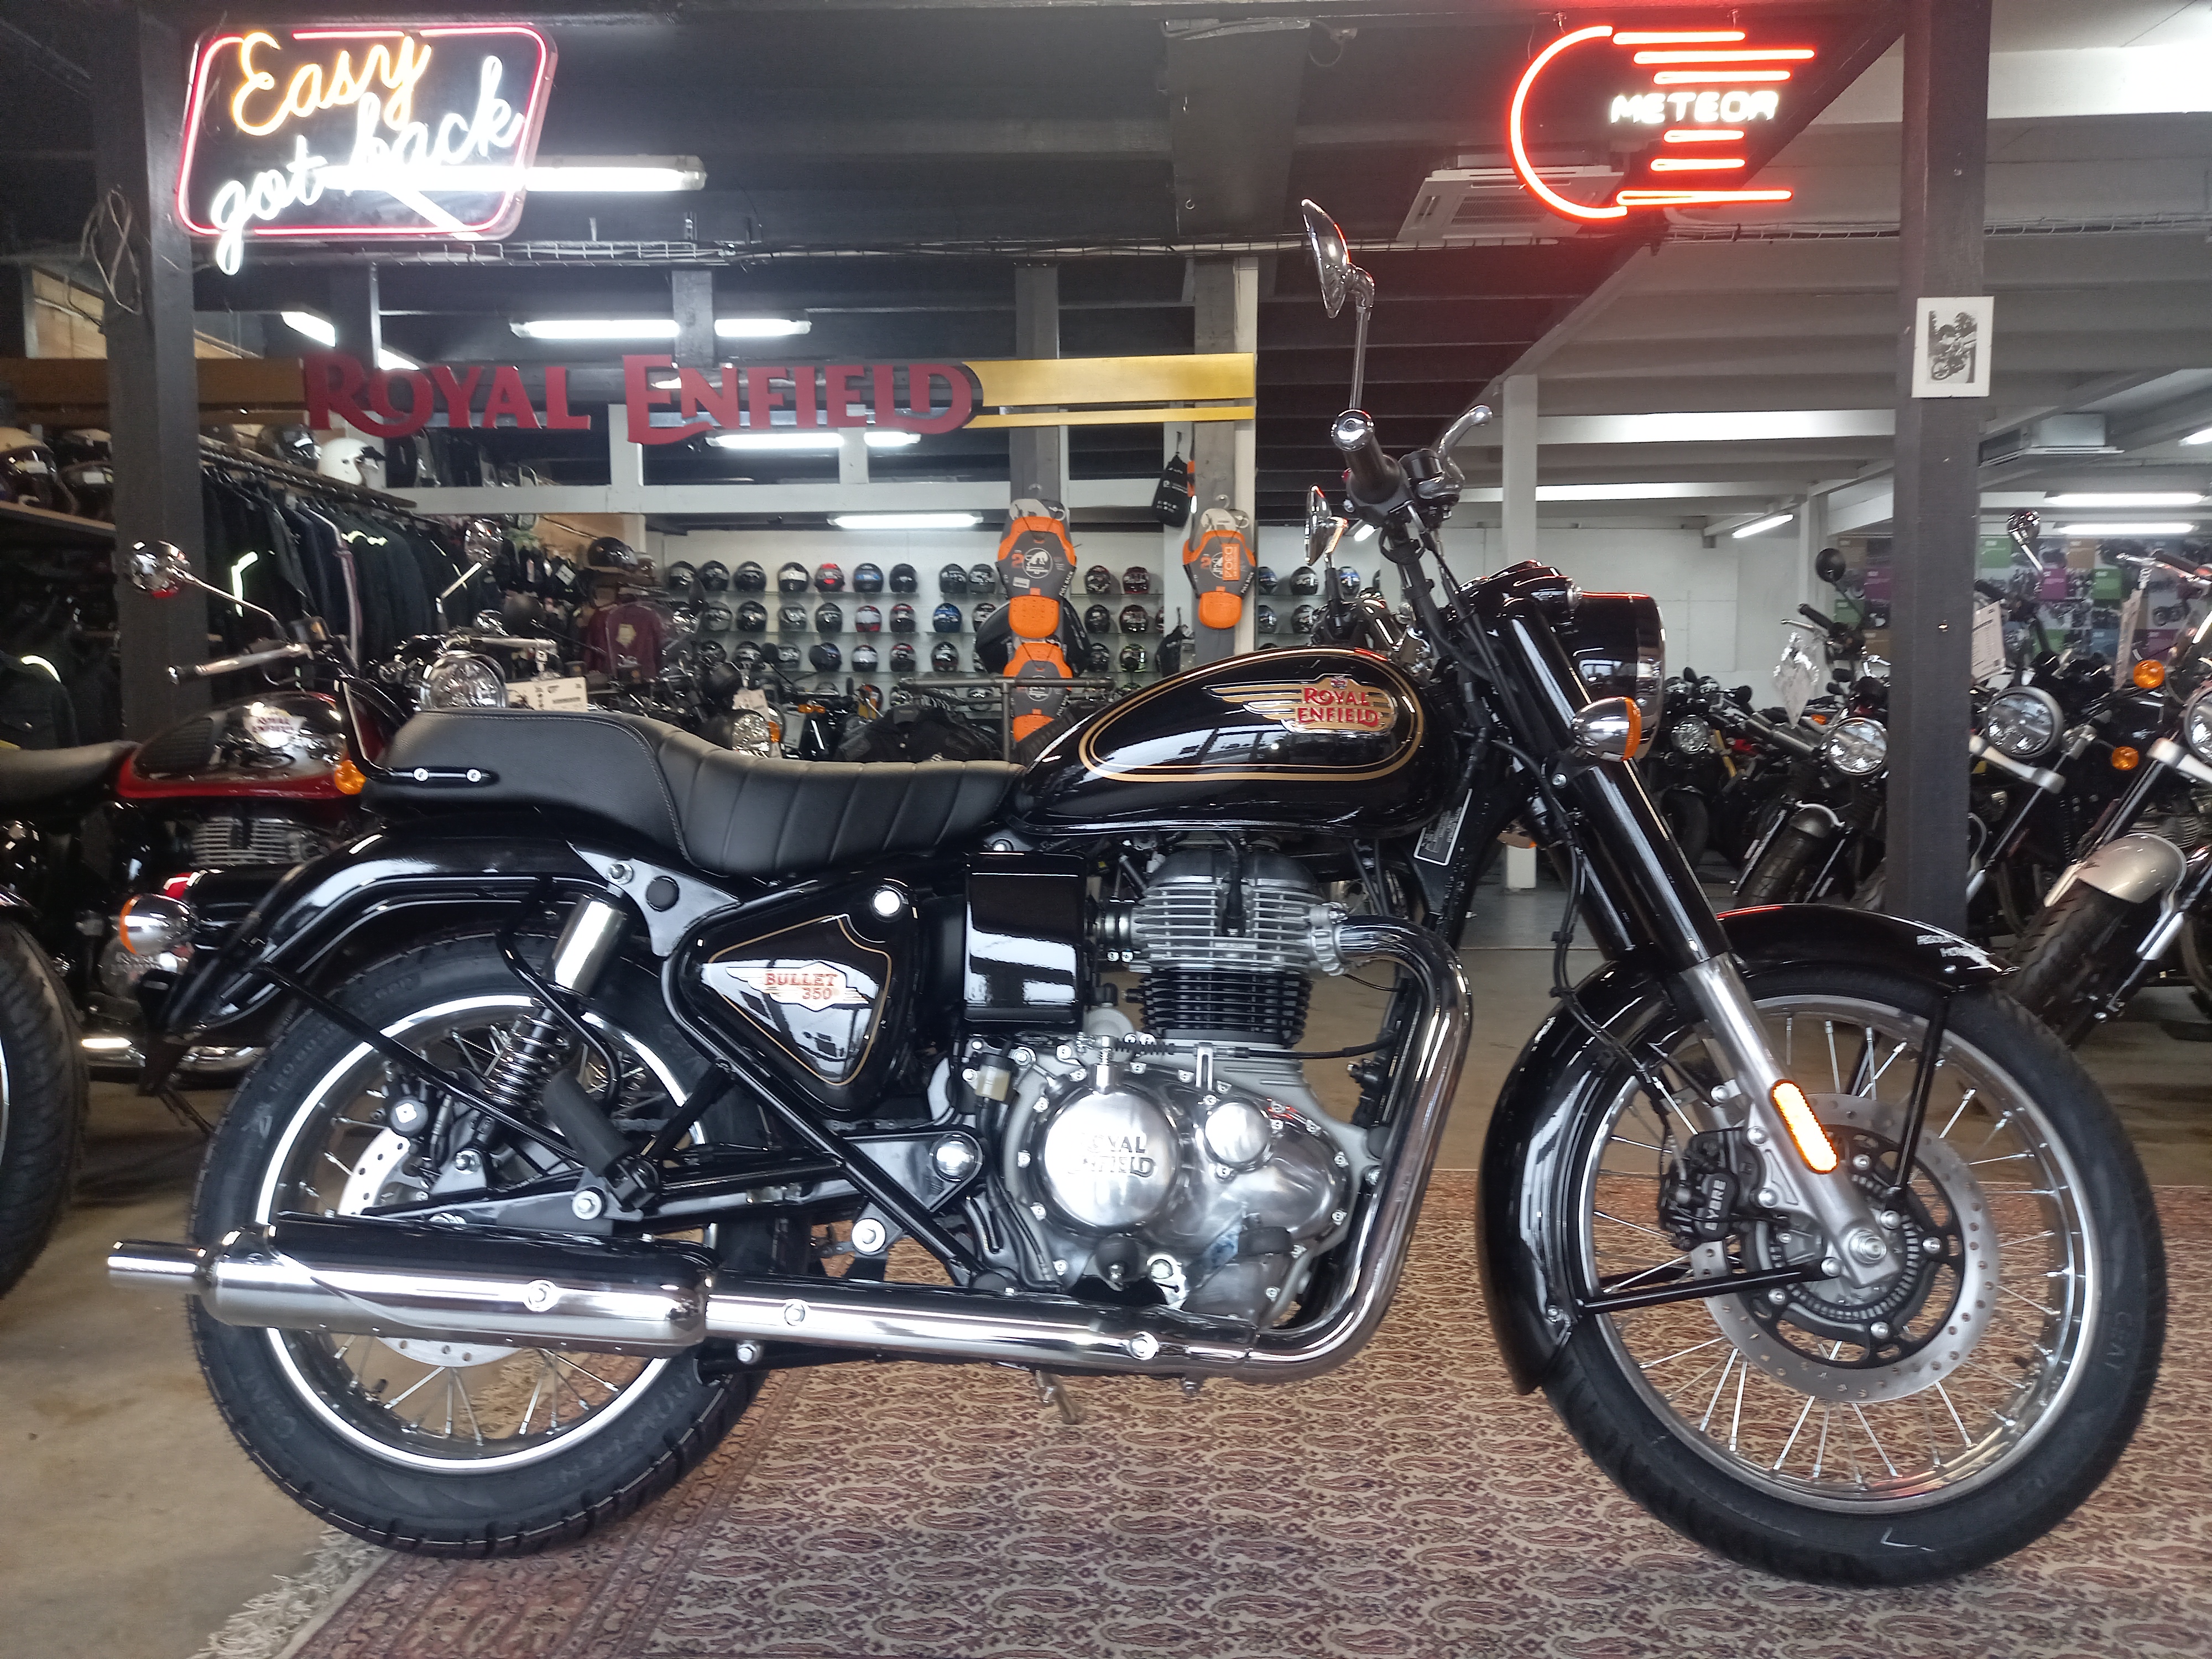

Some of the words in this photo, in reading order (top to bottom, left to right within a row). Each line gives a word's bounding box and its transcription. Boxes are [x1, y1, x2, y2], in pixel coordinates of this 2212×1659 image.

[231, 31, 432, 136] Easy
[1610, 90, 1780, 124] METEOR
[210, 135, 328, 275] got
[303, 352, 591, 438] ROYAL
[625, 355, 970, 444] ENFIELD
[1302, 687, 1371, 706] ROYAL
[1297, 707, 1379, 727] ENFIELD
[764, 973, 838, 986] BULLET
[802, 988, 833, 1000] 350
